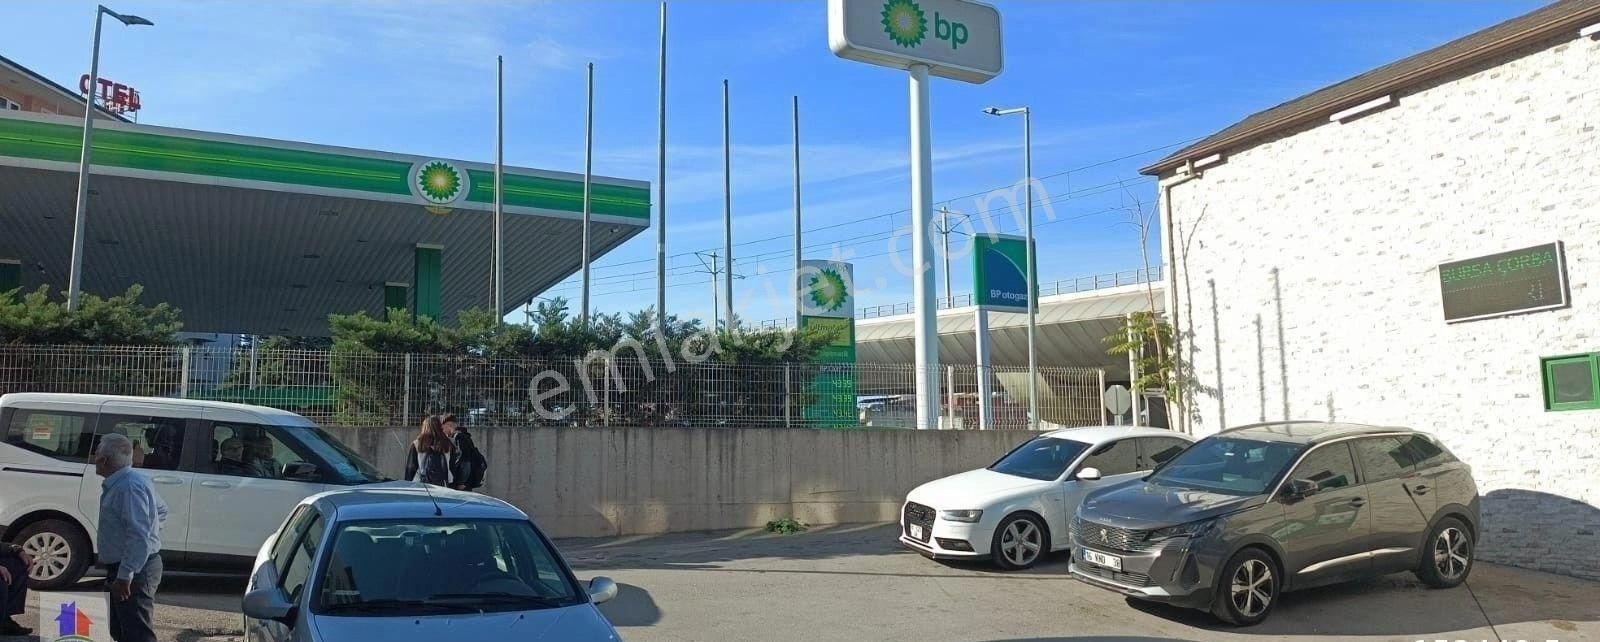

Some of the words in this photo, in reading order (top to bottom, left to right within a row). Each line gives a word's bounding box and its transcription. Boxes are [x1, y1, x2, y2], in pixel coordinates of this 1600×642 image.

[934, 11, 969, 50] bp
[1441, 262, 1494, 283] BURSA
[990, 289, 1001, 299] BP
